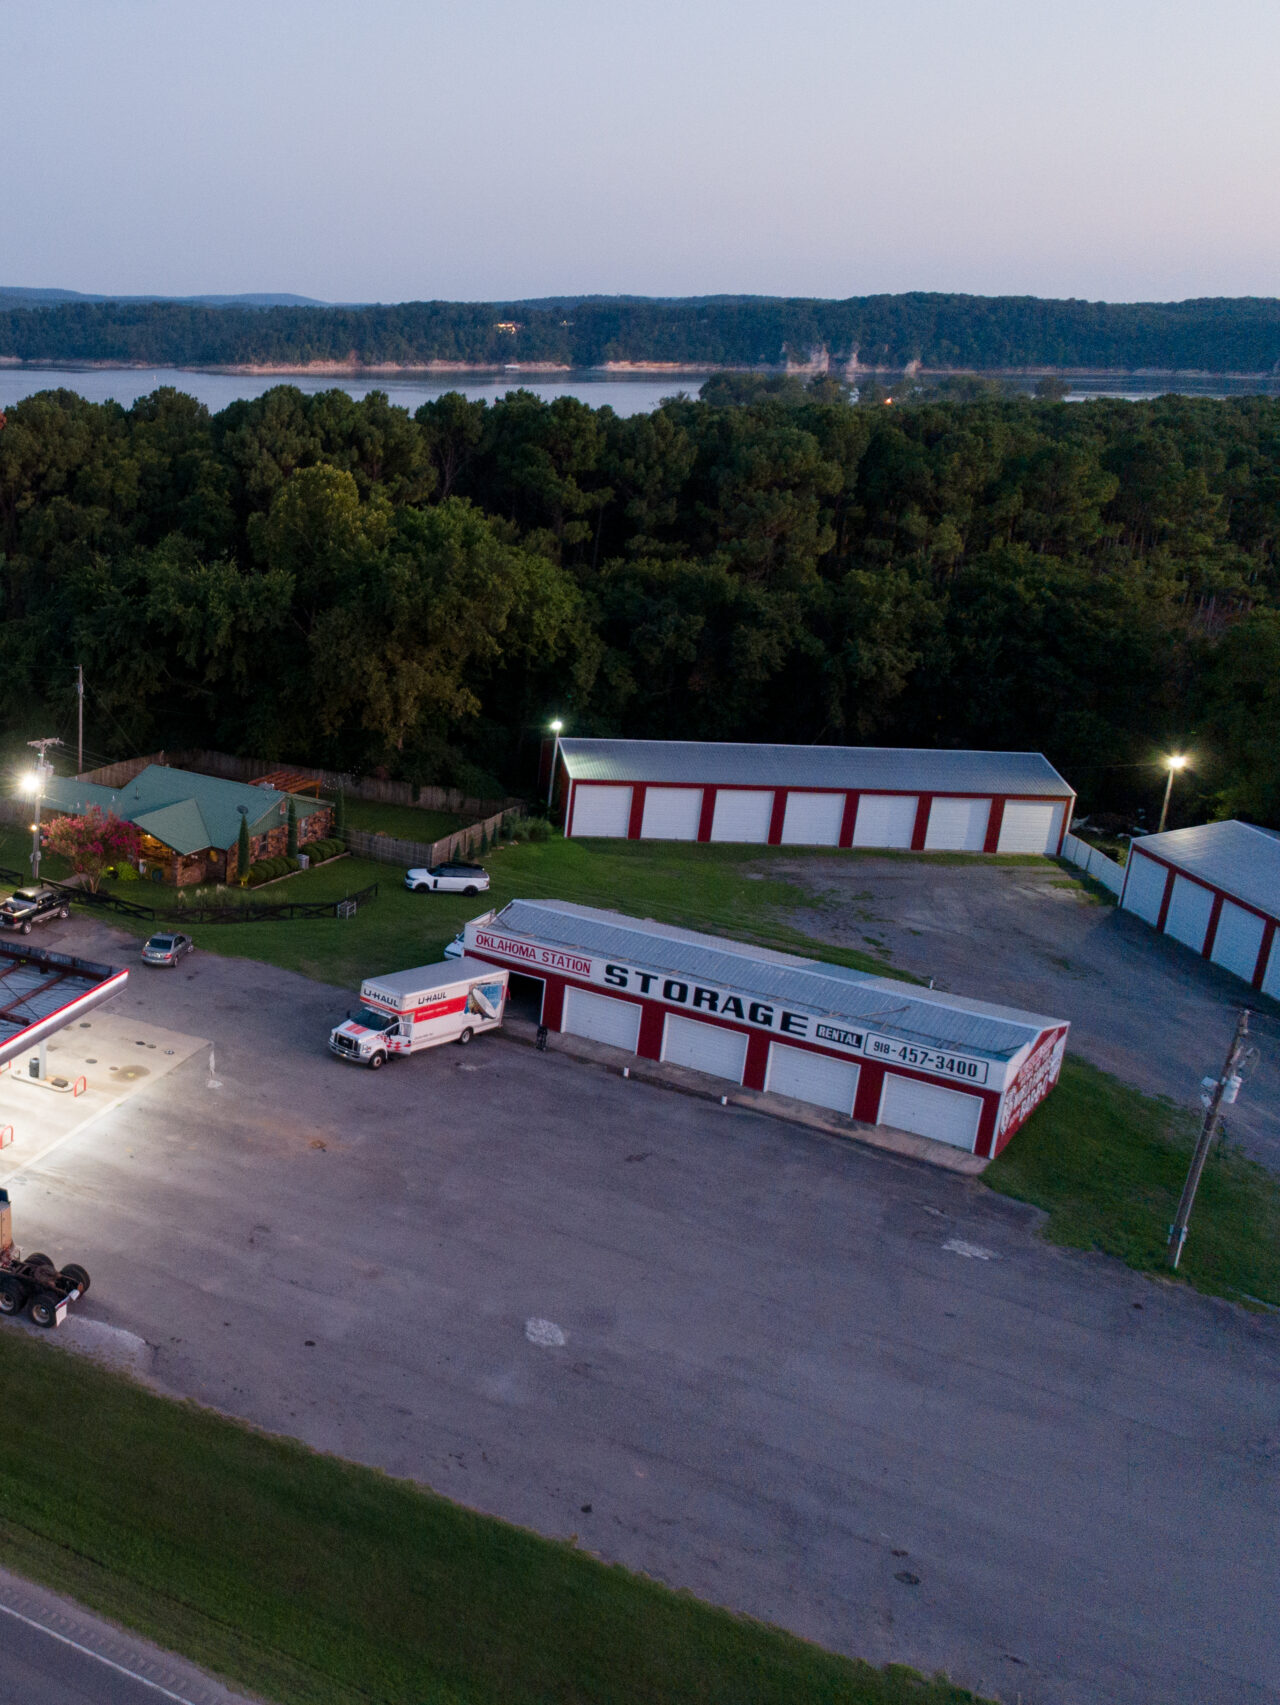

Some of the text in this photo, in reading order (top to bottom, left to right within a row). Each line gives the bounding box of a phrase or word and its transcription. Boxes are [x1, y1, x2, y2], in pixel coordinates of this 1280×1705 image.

[476, 934, 591, 974] OKLAHOMA STATION
[417, 991, 447, 1005] U-HAUL
[604, 964, 809, 1037] STORAGE
[819, 1026, 860, 1047] RENTAL
[873, 1040, 978, 1078] 918-457-3400
